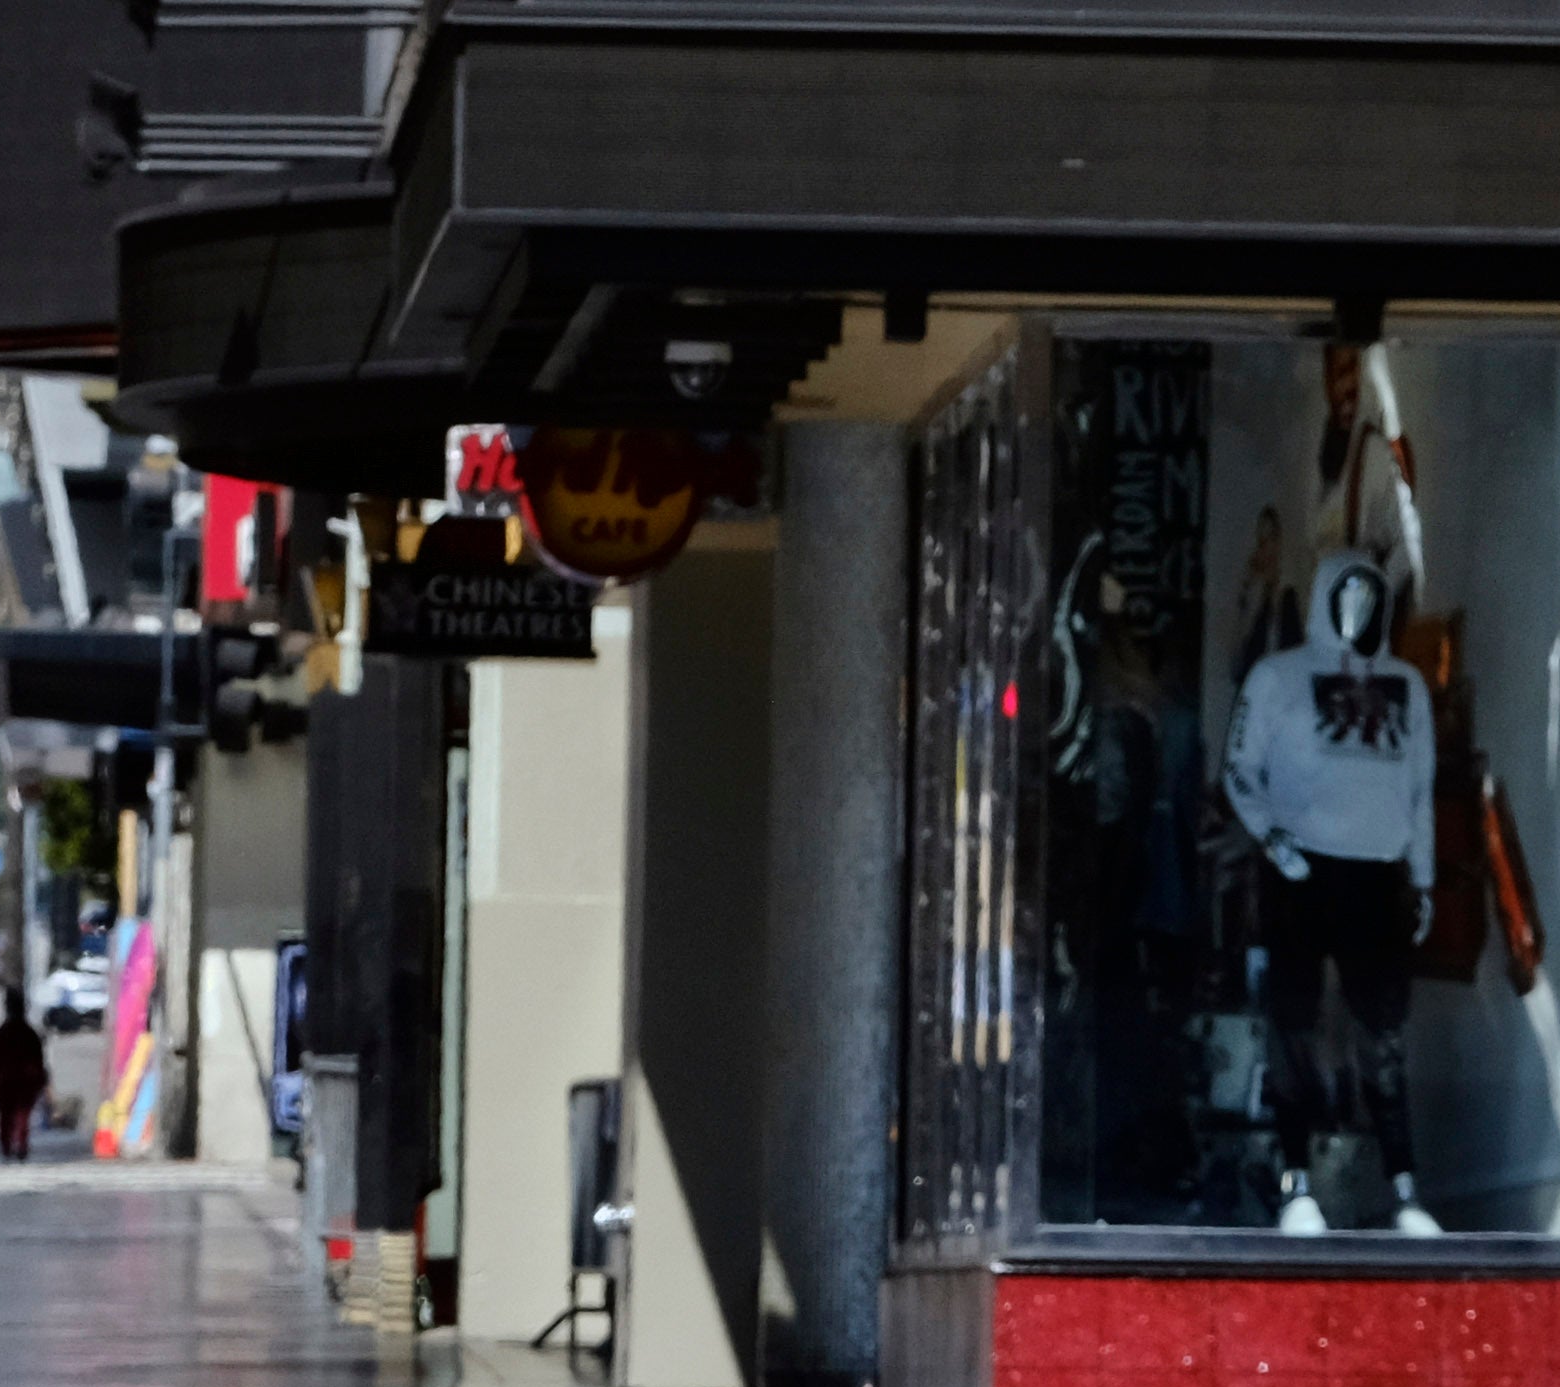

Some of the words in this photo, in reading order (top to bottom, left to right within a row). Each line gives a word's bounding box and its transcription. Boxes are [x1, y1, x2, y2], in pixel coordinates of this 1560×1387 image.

[573, 516, 649, 544] CAFE
[425, 575, 583, 608] CHINESE
[429, 609, 586, 640] THEATRES
